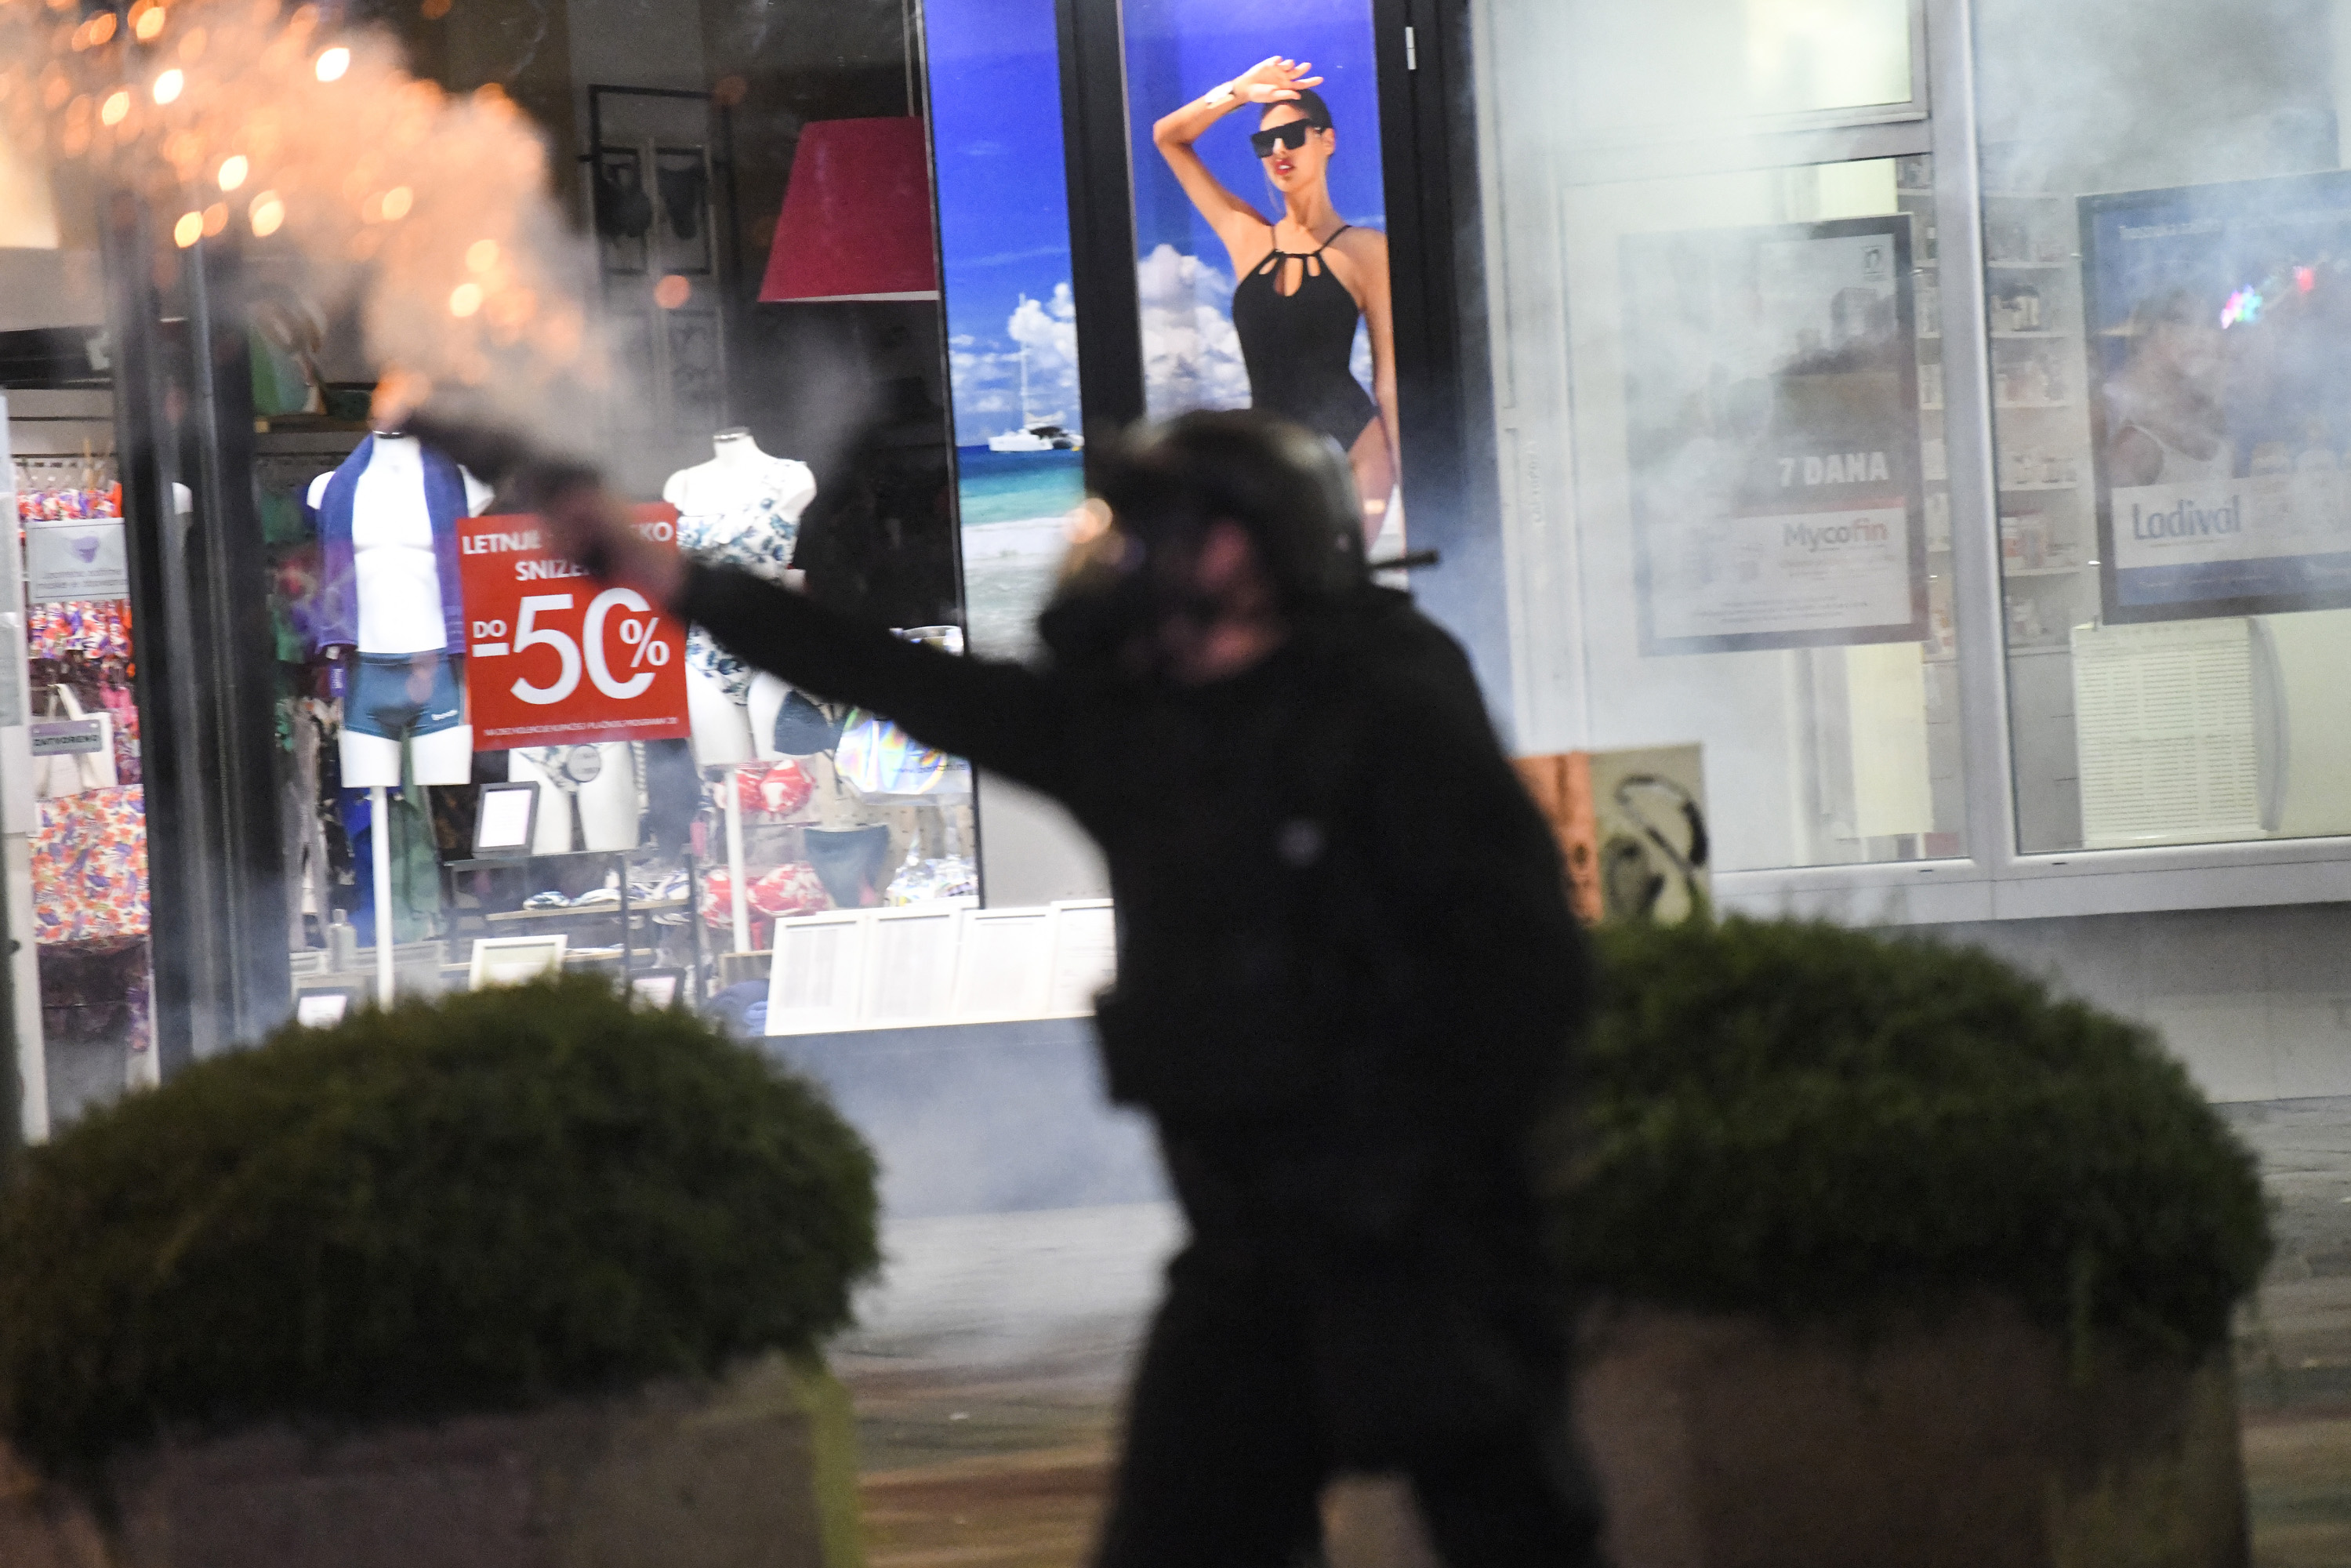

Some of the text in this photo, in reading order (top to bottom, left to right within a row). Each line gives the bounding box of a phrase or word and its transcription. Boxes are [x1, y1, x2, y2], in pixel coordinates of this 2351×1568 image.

[1777, 452, 1888, 487] 7 DANA
[1784, 517, 1888, 552] Mycofin
[515, 558, 591, 581] SNIZE
[472, 587, 670, 705] -50%
[473, 619, 507, 639] DO
